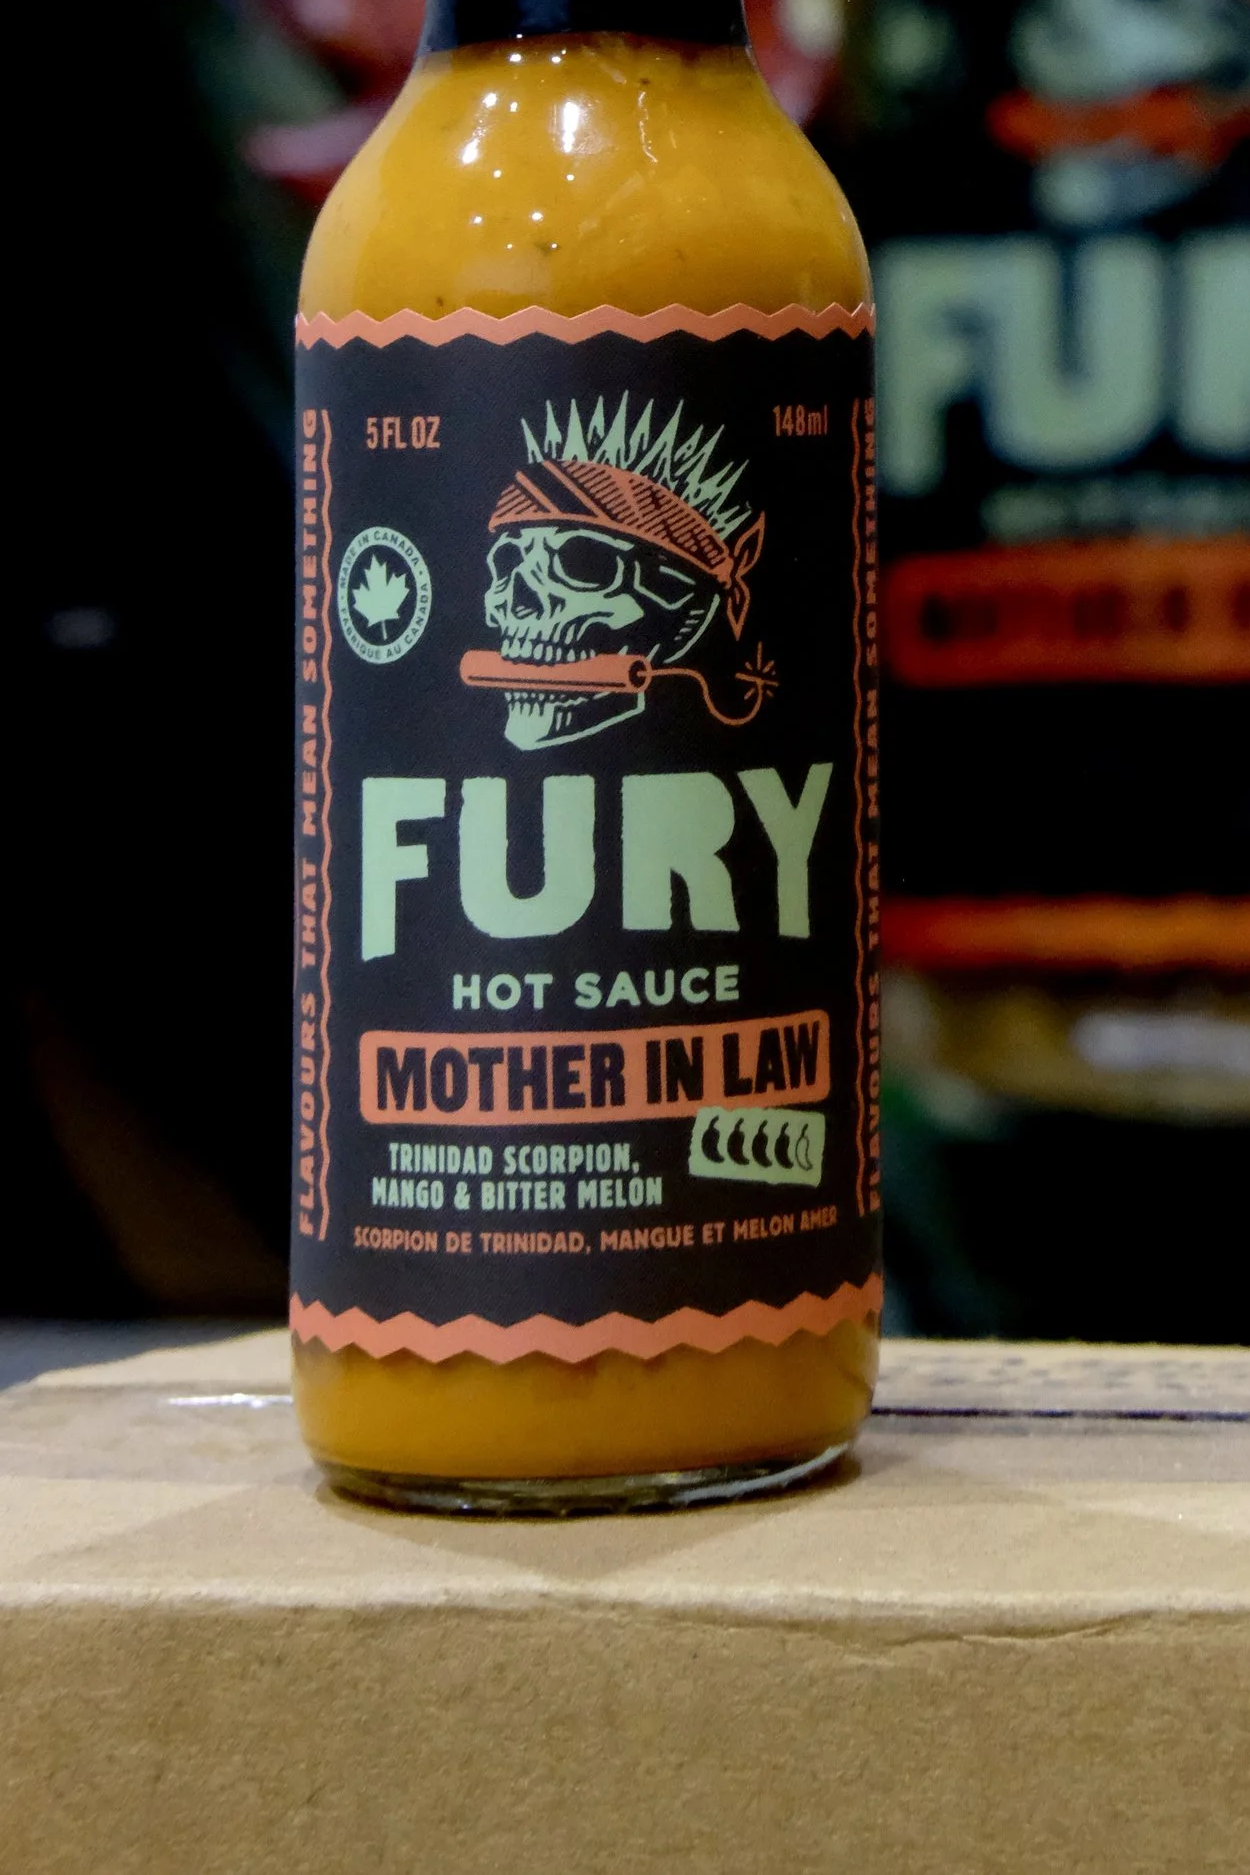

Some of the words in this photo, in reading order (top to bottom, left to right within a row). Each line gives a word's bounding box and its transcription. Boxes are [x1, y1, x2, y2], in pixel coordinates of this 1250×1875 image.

[411, 415, 441, 450] OZ
[772, 404, 829, 438] 148ml
[302, 408, 318, 684] SOMETHING
[340, 547, 357, 589] MADE
[358, 534, 370, 545] IN
[373, 530, 420, 567] CANADA
[340, 607, 382, 660] FABRIQUE
[386, 646, 402, 659] AU
[403, 582, 429, 645] CANADA
[302, 705, 318, 836] MEAN
[361, 762, 833, 962] FURY
[301, 858, 317, 969] THAT
[452, 972, 553, 1010] HOT
[575, 964, 740, 1008] SAUCE
[376, 1042, 626, 1114] MOTHER
[645, 1036, 705, 1104] IN
[722, 1021, 821, 1098] LAW
[299, 991, 317, 1237] FLAVOURS
[389, 1142, 493, 1175] TRINIDAD
[503, 1142, 640, 1176] SCORPION,
[372, 1176, 444, 1210] MANGO
[453, 1181, 471, 1211] &
[481, 1180, 567, 1211] BITTER
[577, 1176, 663, 1210] MELON
[353, 1225, 438, 1254] SCORPION
[446, 1231, 472, 1254] DE
[480, 1231, 592, 1255] TRINIDAD,
[600, 1226, 695, 1253] MANGUE
[702, 1222, 725, 1246] ET
[733, 1213, 795, 1242] MELON
[800, 1205, 838, 1231] AMER
